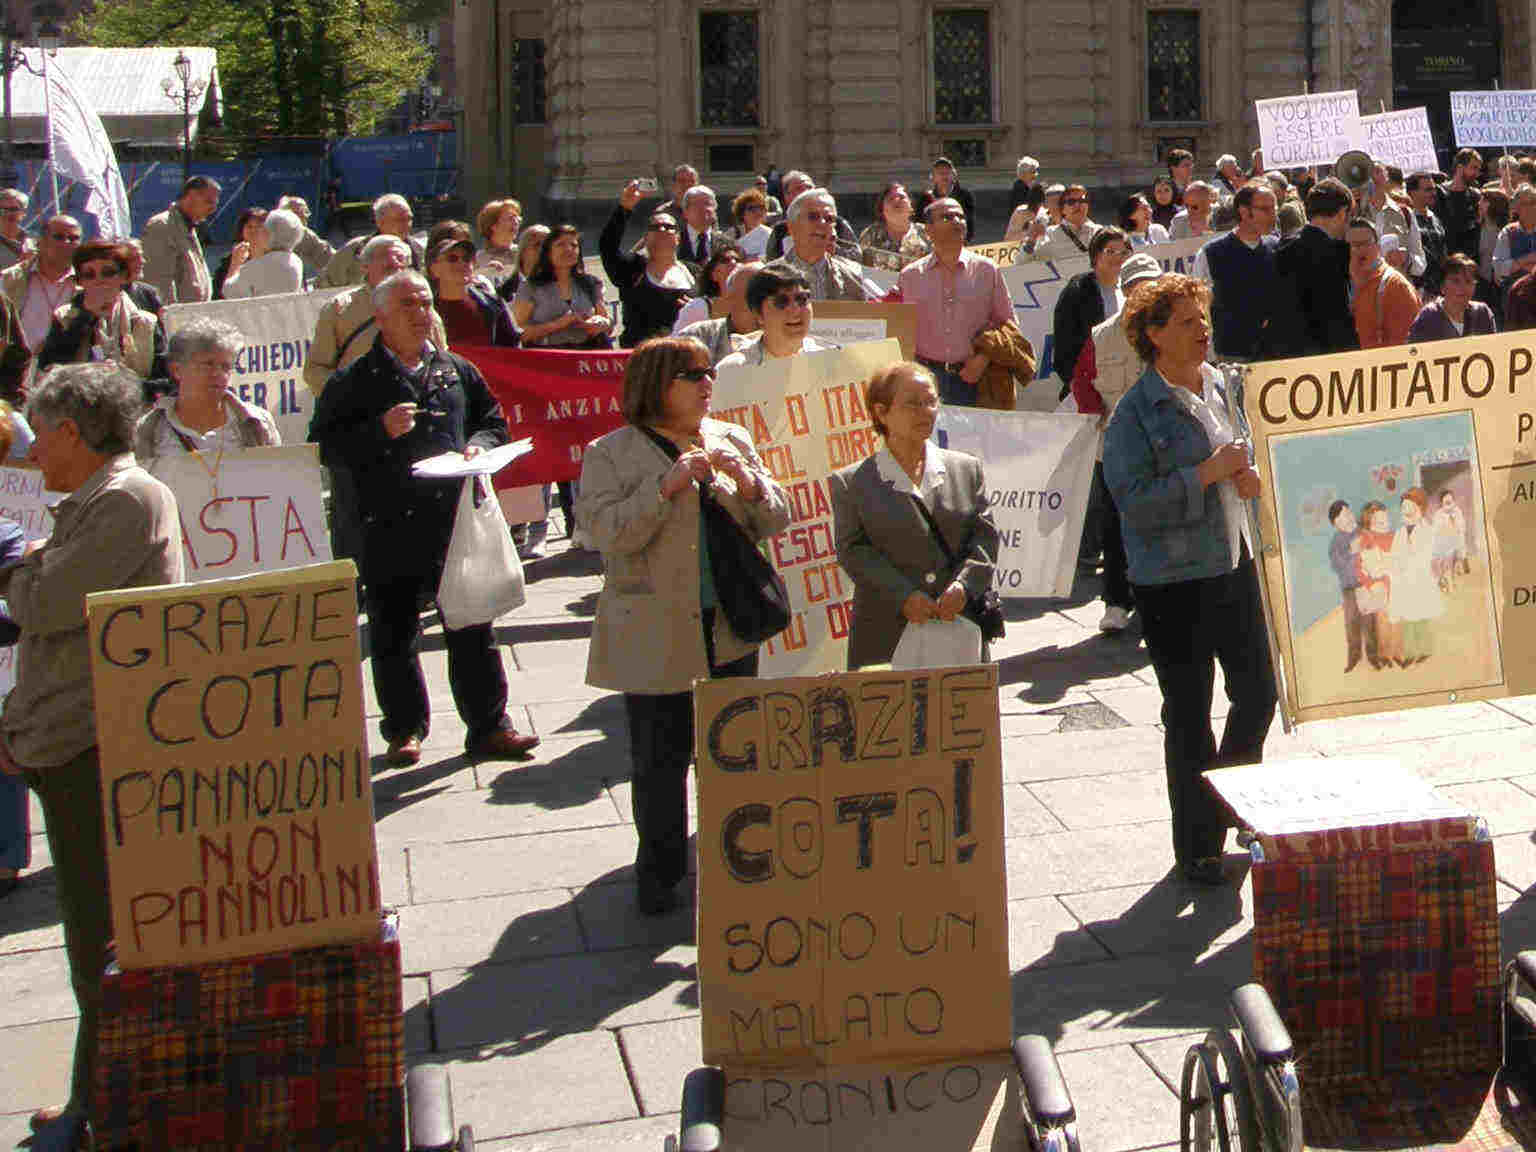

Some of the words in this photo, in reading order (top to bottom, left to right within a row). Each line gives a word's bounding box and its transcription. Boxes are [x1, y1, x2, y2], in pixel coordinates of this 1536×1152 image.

[1273, 119, 1344, 144] ESSERE
[999, 247, 1020, 264] PO
[228, 382, 268, 410] ER
[280, 378, 302, 414] IL
[547, 396, 622, 421] ANZIA
[1259, 352, 1494, 424] COMITATO
[989, 490, 1064, 510] DIRITTO
[178, 495, 317, 571] ASTA
[772, 523, 837, 569] ESCL
[1000, 529, 1022, 548] NE
[996, 568, 1023, 588] VO
[100, 587, 351, 668] GRAZIE
[146, 659, 343, 745] COTA
[708, 668, 993, 772] GRAZIE
[111, 748, 363, 847] PANNOLONI
[720, 758, 979, 884] COTA!
[198, 817, 324, 888] NON
[130, 860, 380, 953] PANNOLINI
[723, 911, 877, 975] SONO
[899, 911, 977, 956] UN
[729, 986, 945, 1053] MALATO
[724, 1064, 982, 1128] CRONICO
